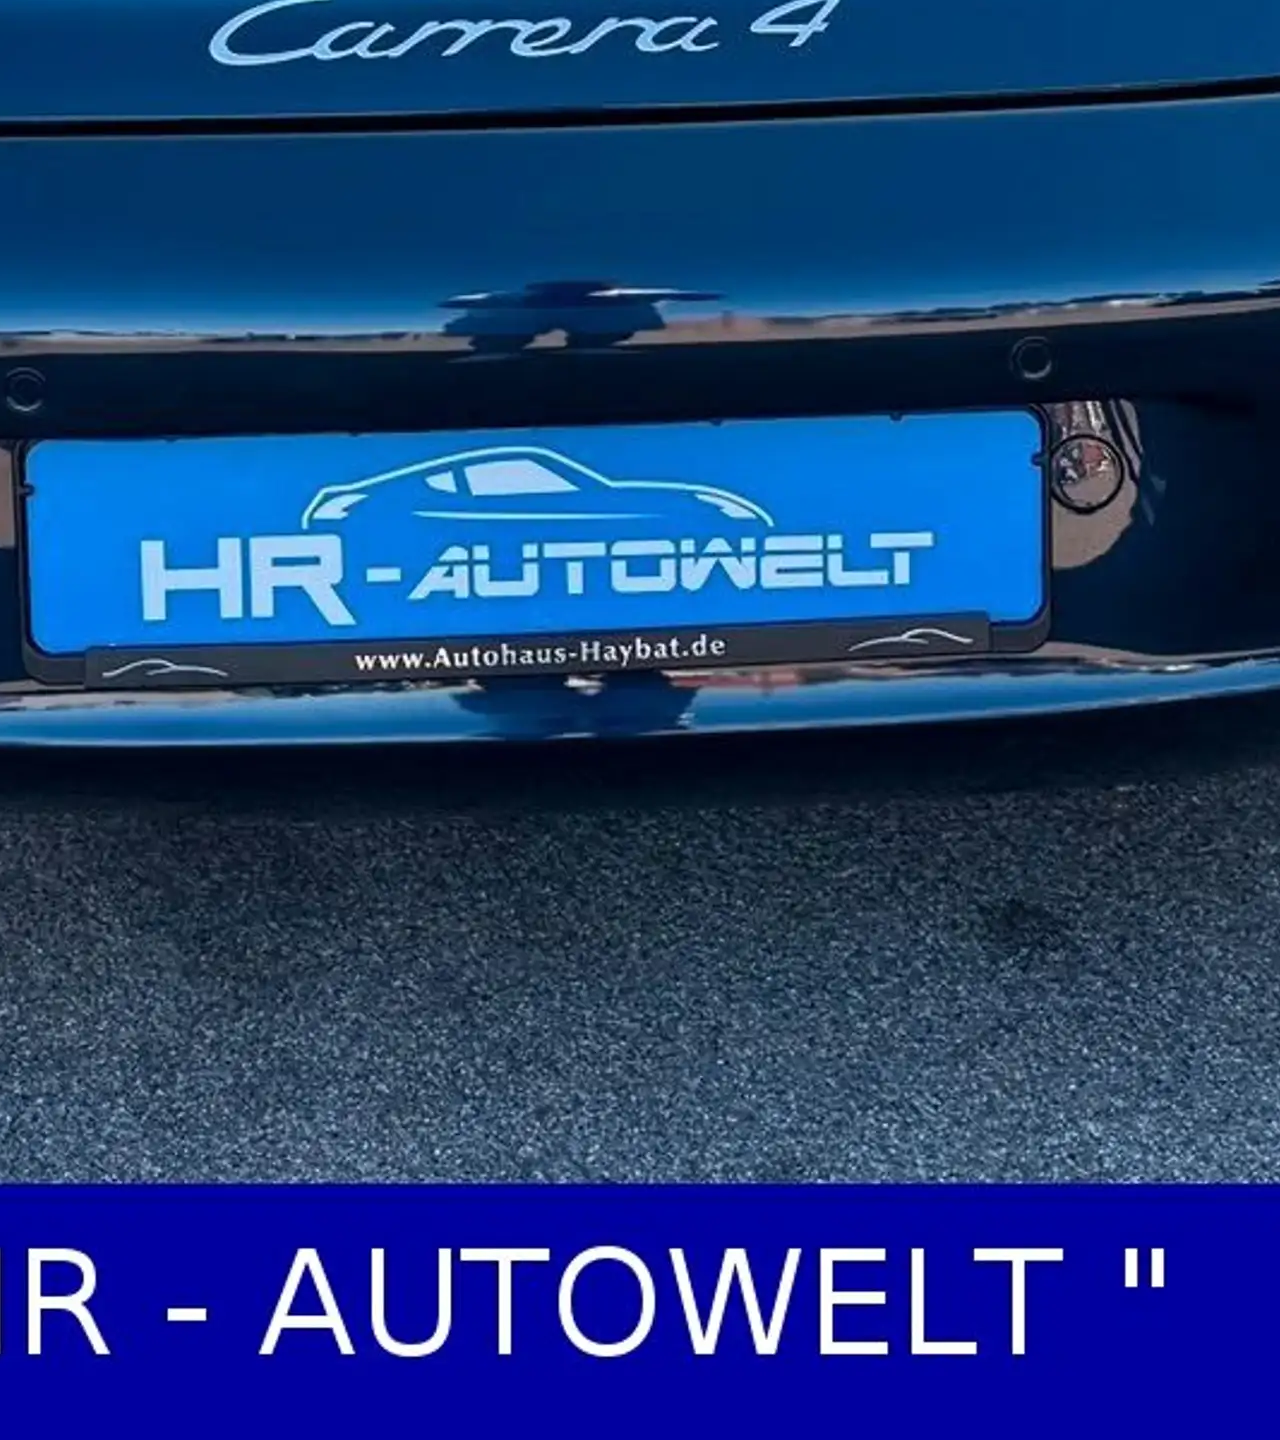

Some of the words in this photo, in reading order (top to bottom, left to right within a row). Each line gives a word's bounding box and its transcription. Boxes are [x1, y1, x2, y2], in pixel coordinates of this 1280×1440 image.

[140, 533, 357, 626] HR
[407, 531, 934, 601] AUTOWELT
[354, 632, 727, 672] www.Autohaus-Haybat.de
